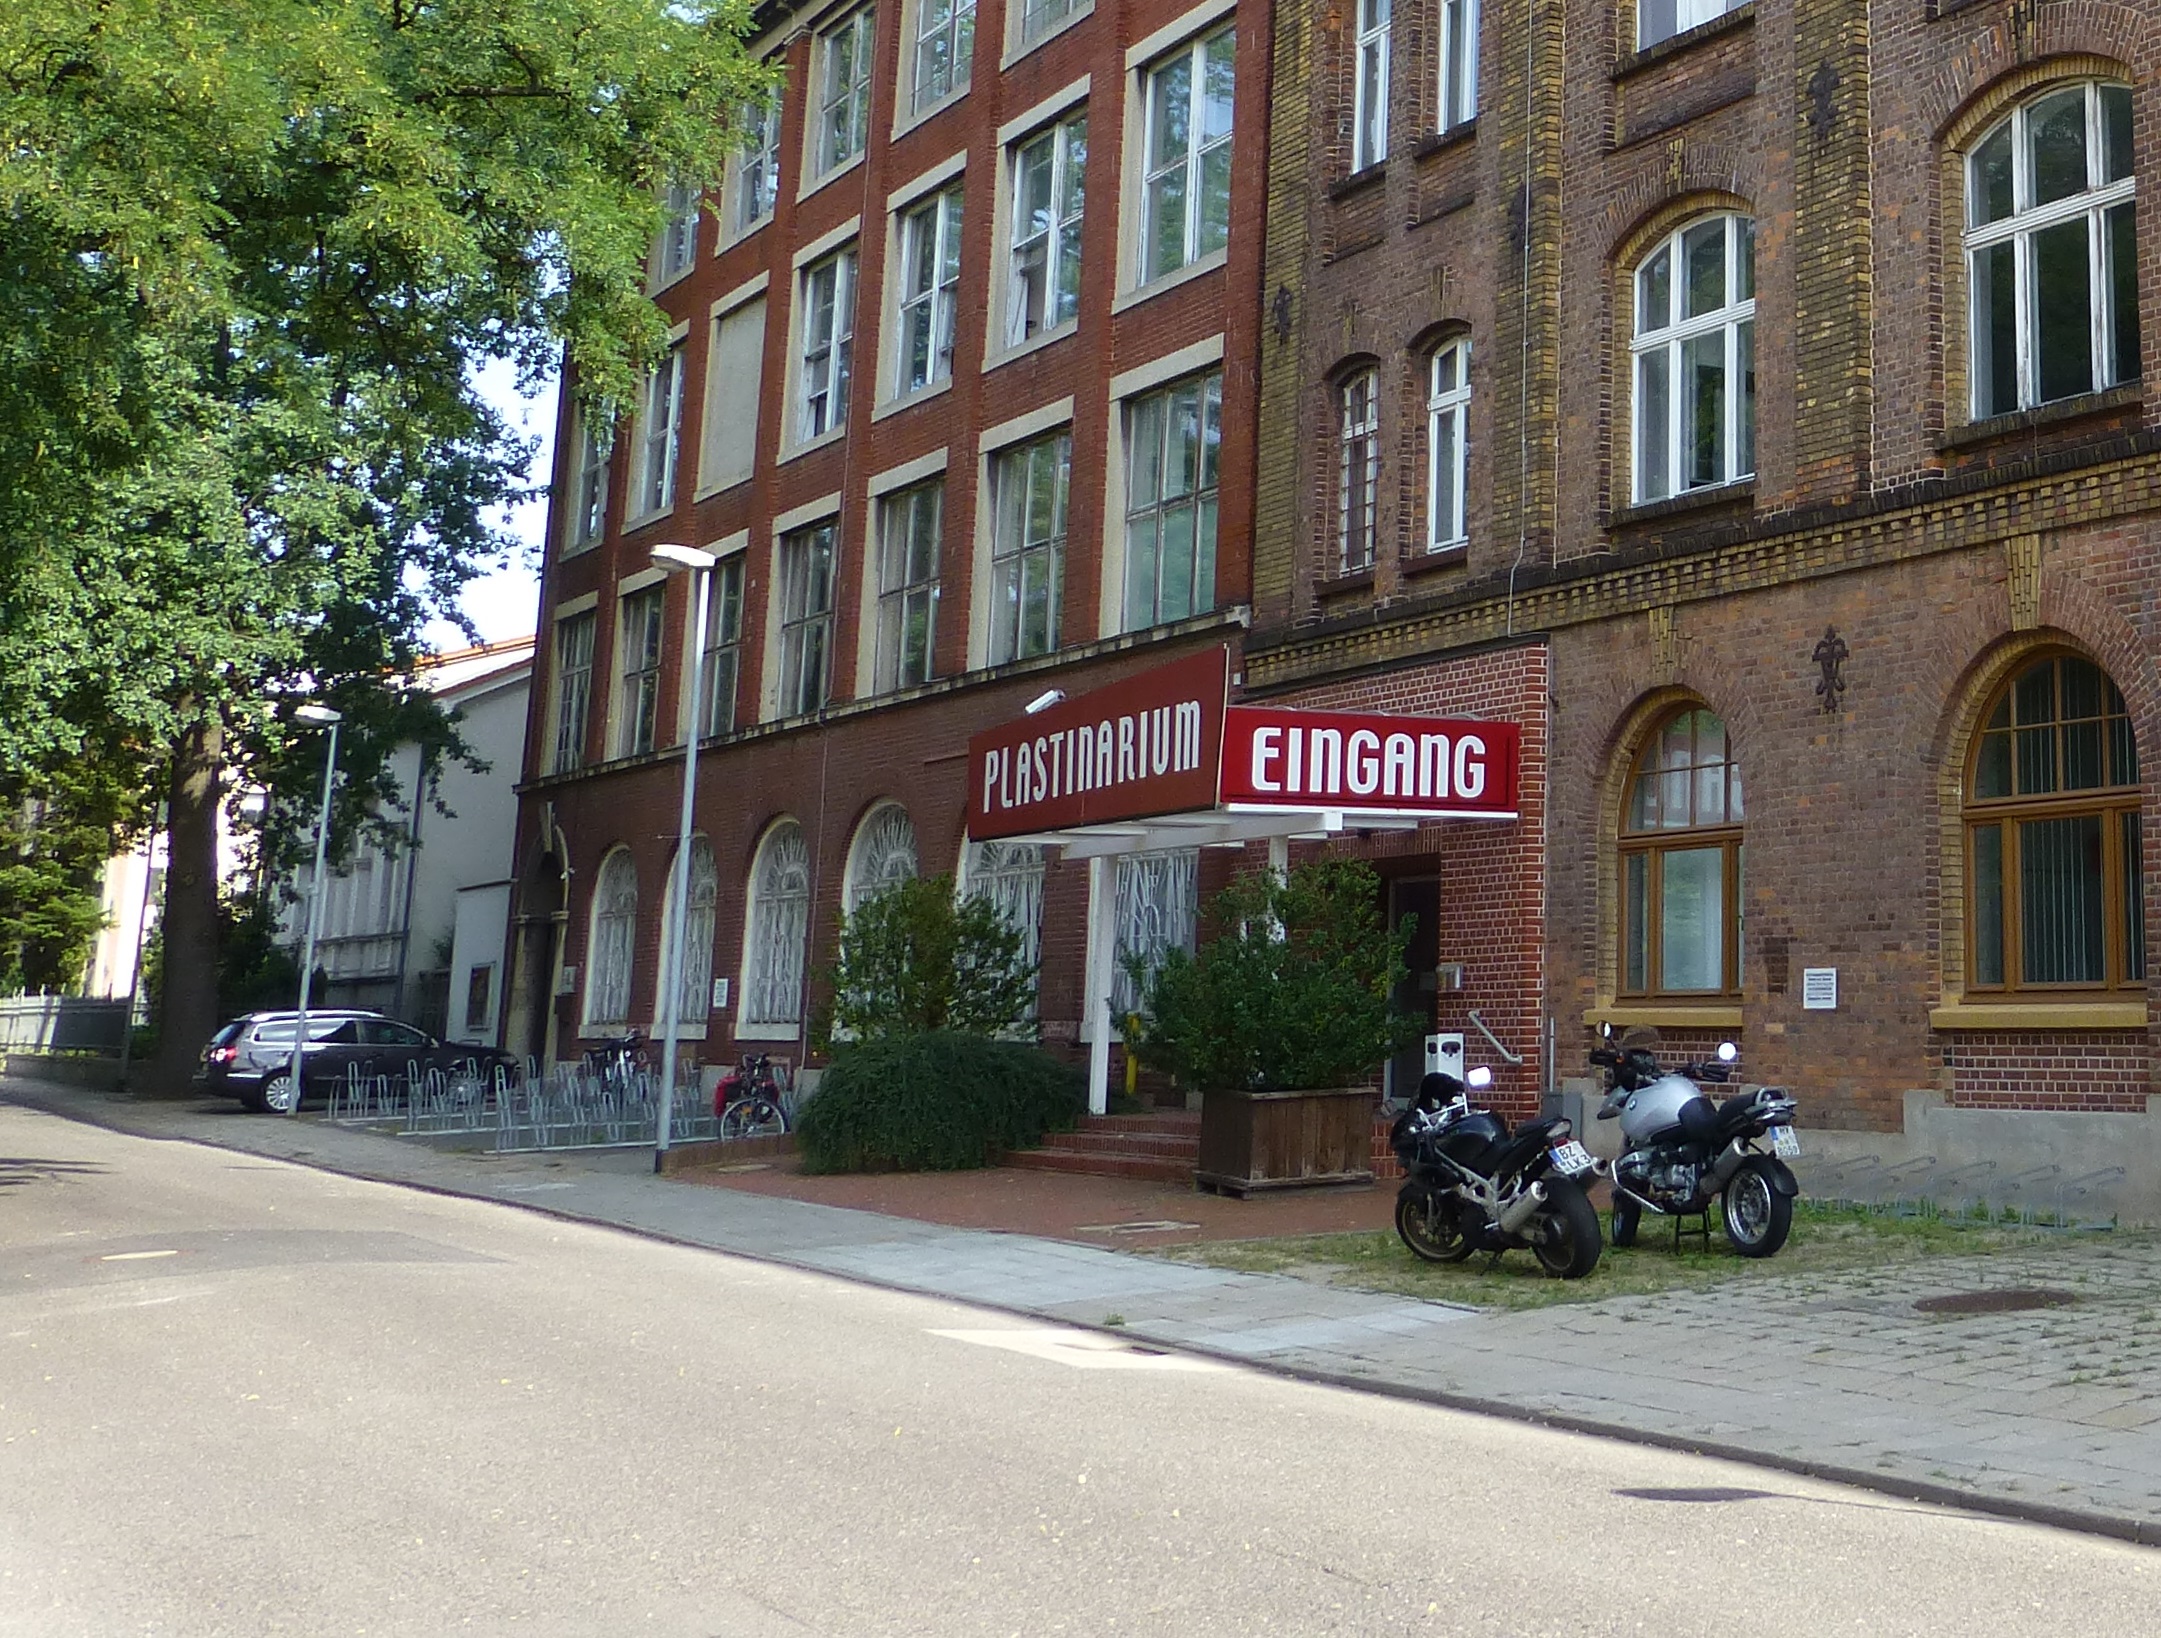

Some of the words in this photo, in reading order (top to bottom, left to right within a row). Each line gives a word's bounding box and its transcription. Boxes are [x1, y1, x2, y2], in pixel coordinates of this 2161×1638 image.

[983, 700, 1200, 814] PLASTINARIUM
[1251, 726, 1486, 798] EINGANG
[1558, 1145, 1576, 1160] BZ
